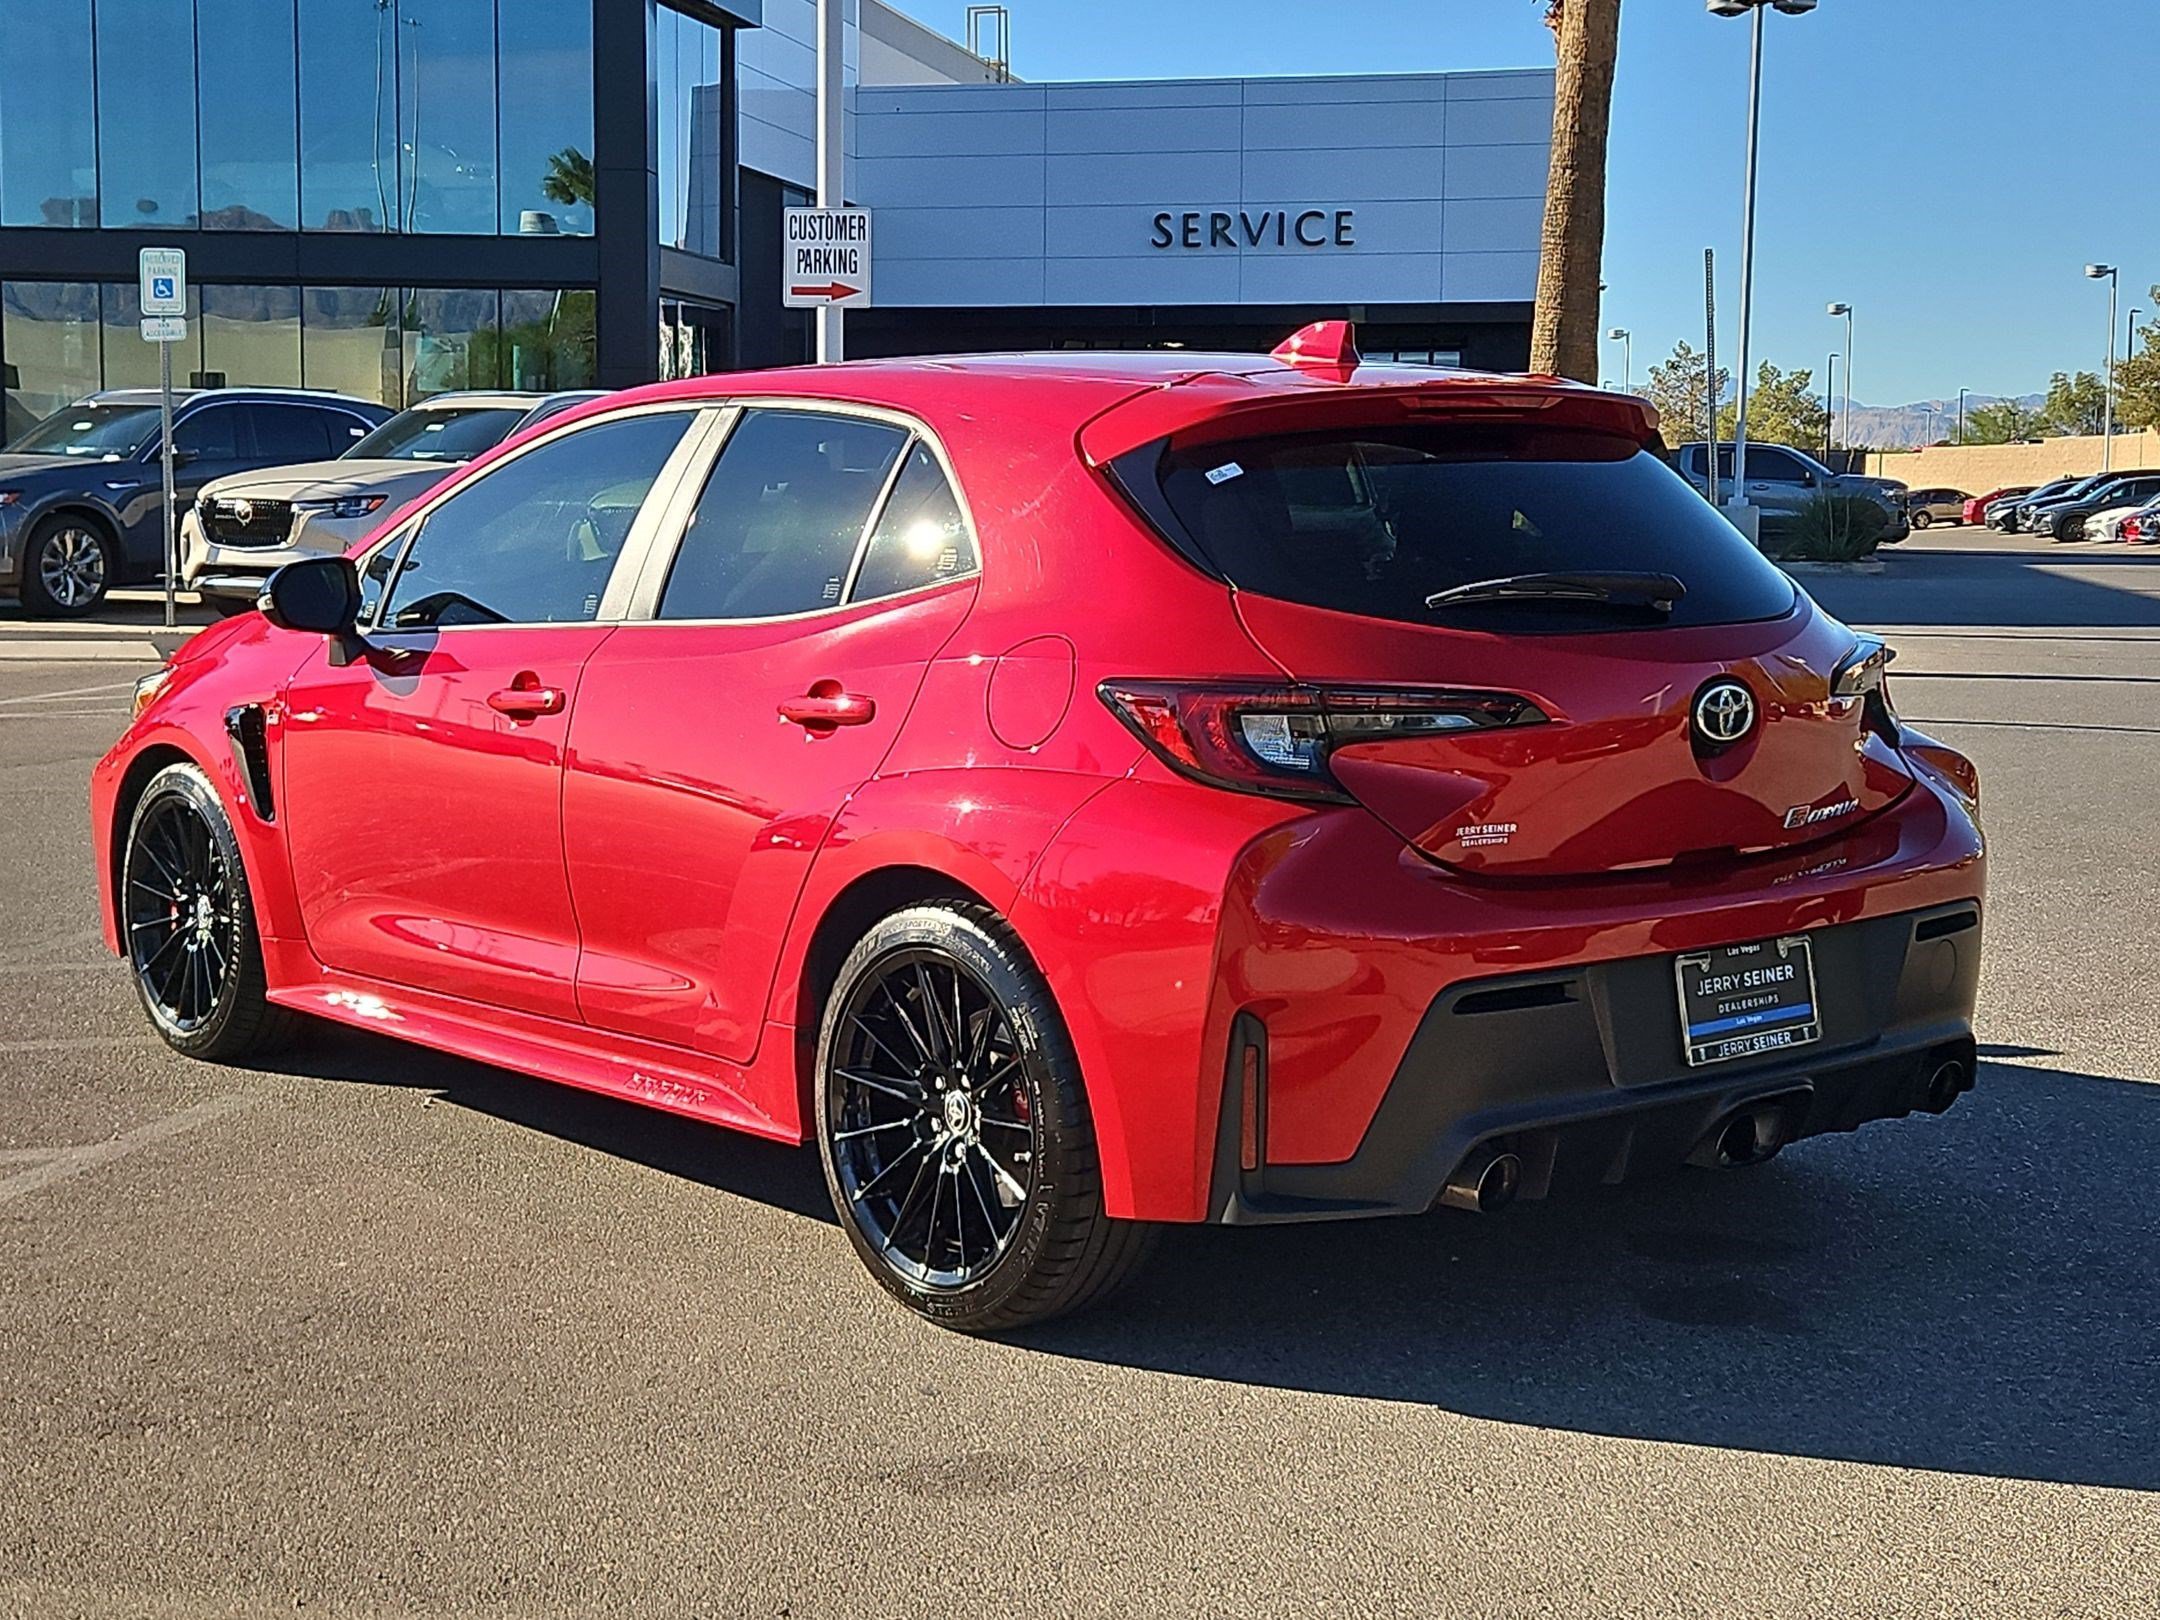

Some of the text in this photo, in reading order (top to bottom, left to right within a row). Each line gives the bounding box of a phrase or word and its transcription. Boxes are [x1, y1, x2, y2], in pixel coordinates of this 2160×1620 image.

[789, 214, 866, 241] CUSTOMER
[1151, 210, 1355, 248] SERVICE
[796, 248, 858, 274] PARKING
[1456, 823, 1517, 836] JERRY SEINER
[1727, 944, 1760, 956] Las Vegas
[1696, 964, 1794, 996] JERRY SEINER
[1718, 994, 1780, 1014] DEALERSHIPS
[1736, 1014, 1762, 1025] Las Vegas
[1718, 1032, 1792, 1057] JERRY SEINER
